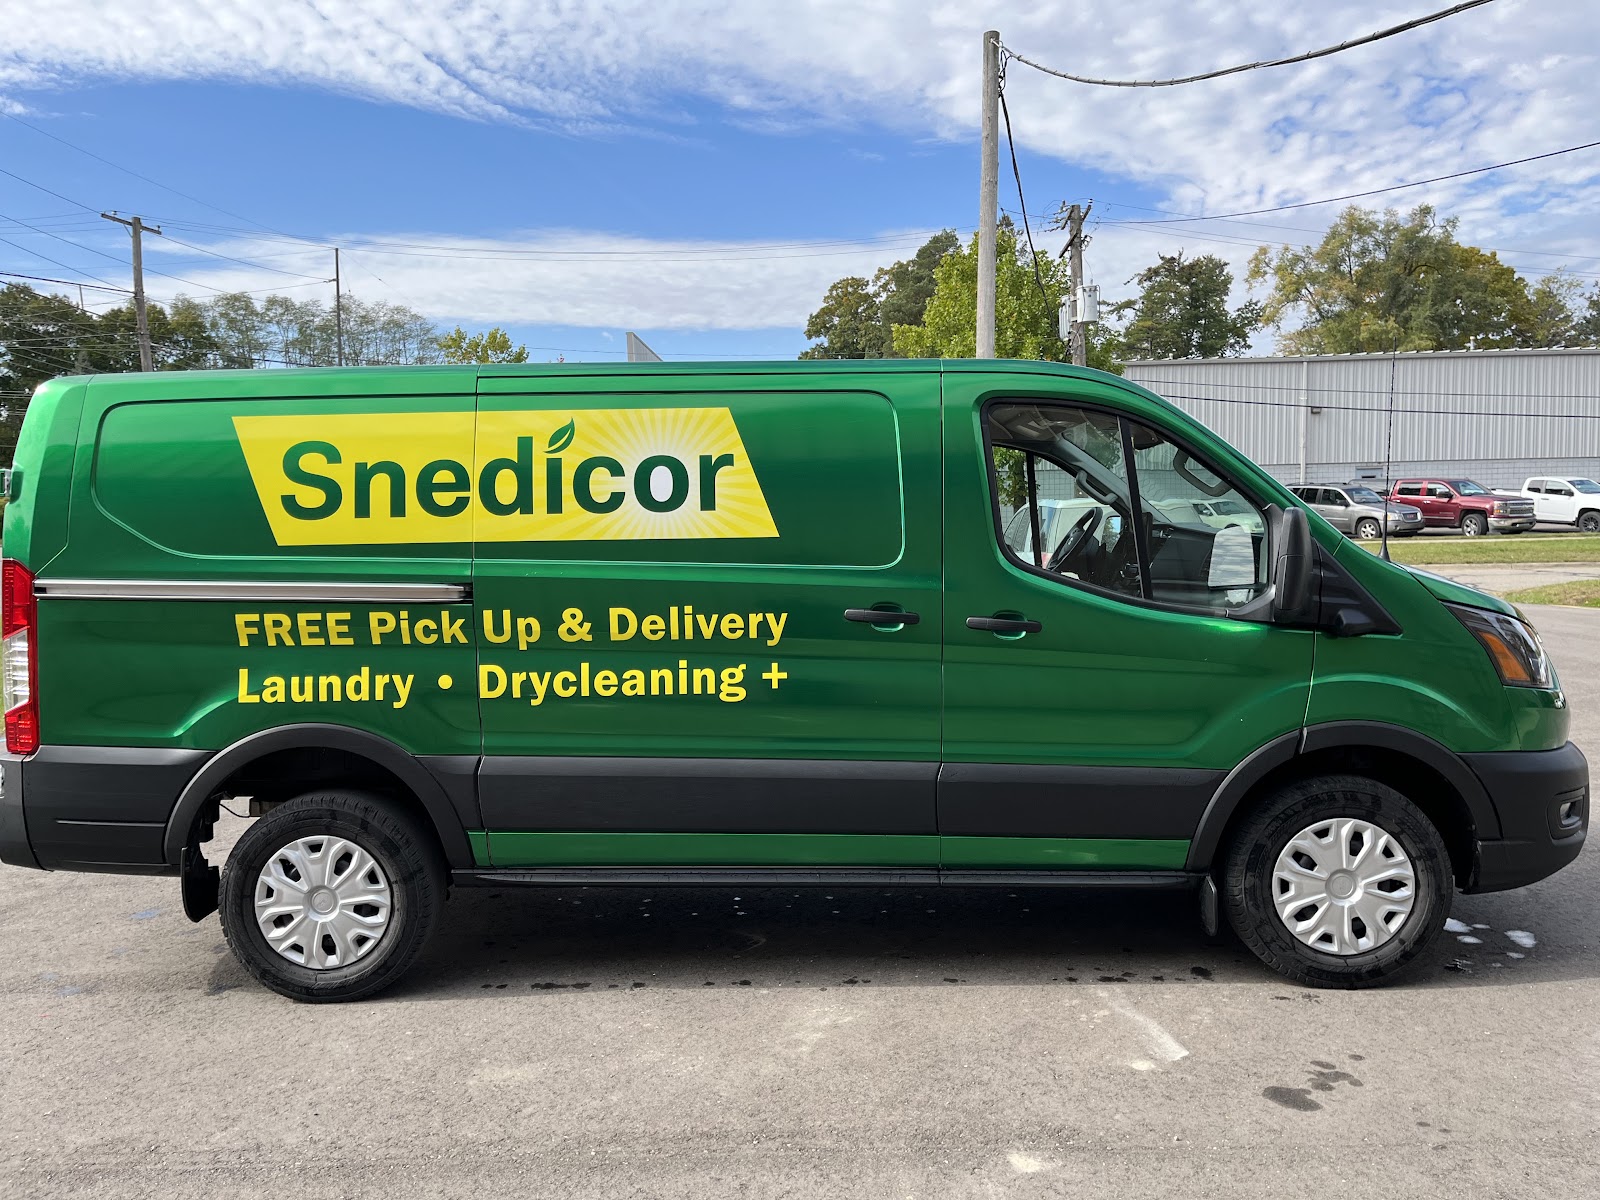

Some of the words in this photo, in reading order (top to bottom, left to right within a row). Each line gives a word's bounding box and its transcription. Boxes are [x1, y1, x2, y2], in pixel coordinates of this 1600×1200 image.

[280, 417, 735, 521] Snedicor
[235, 611, 355, 647] FREE
[368, 610, 469, 645] Pick
[482, 608, 541, 651] Up
[557, 606, 593, 643] &
[608, 605, 788, 647] Delivery
[237, 666, 415, 709] Laundry
[478, 662, 747, 706] Drycleaning
